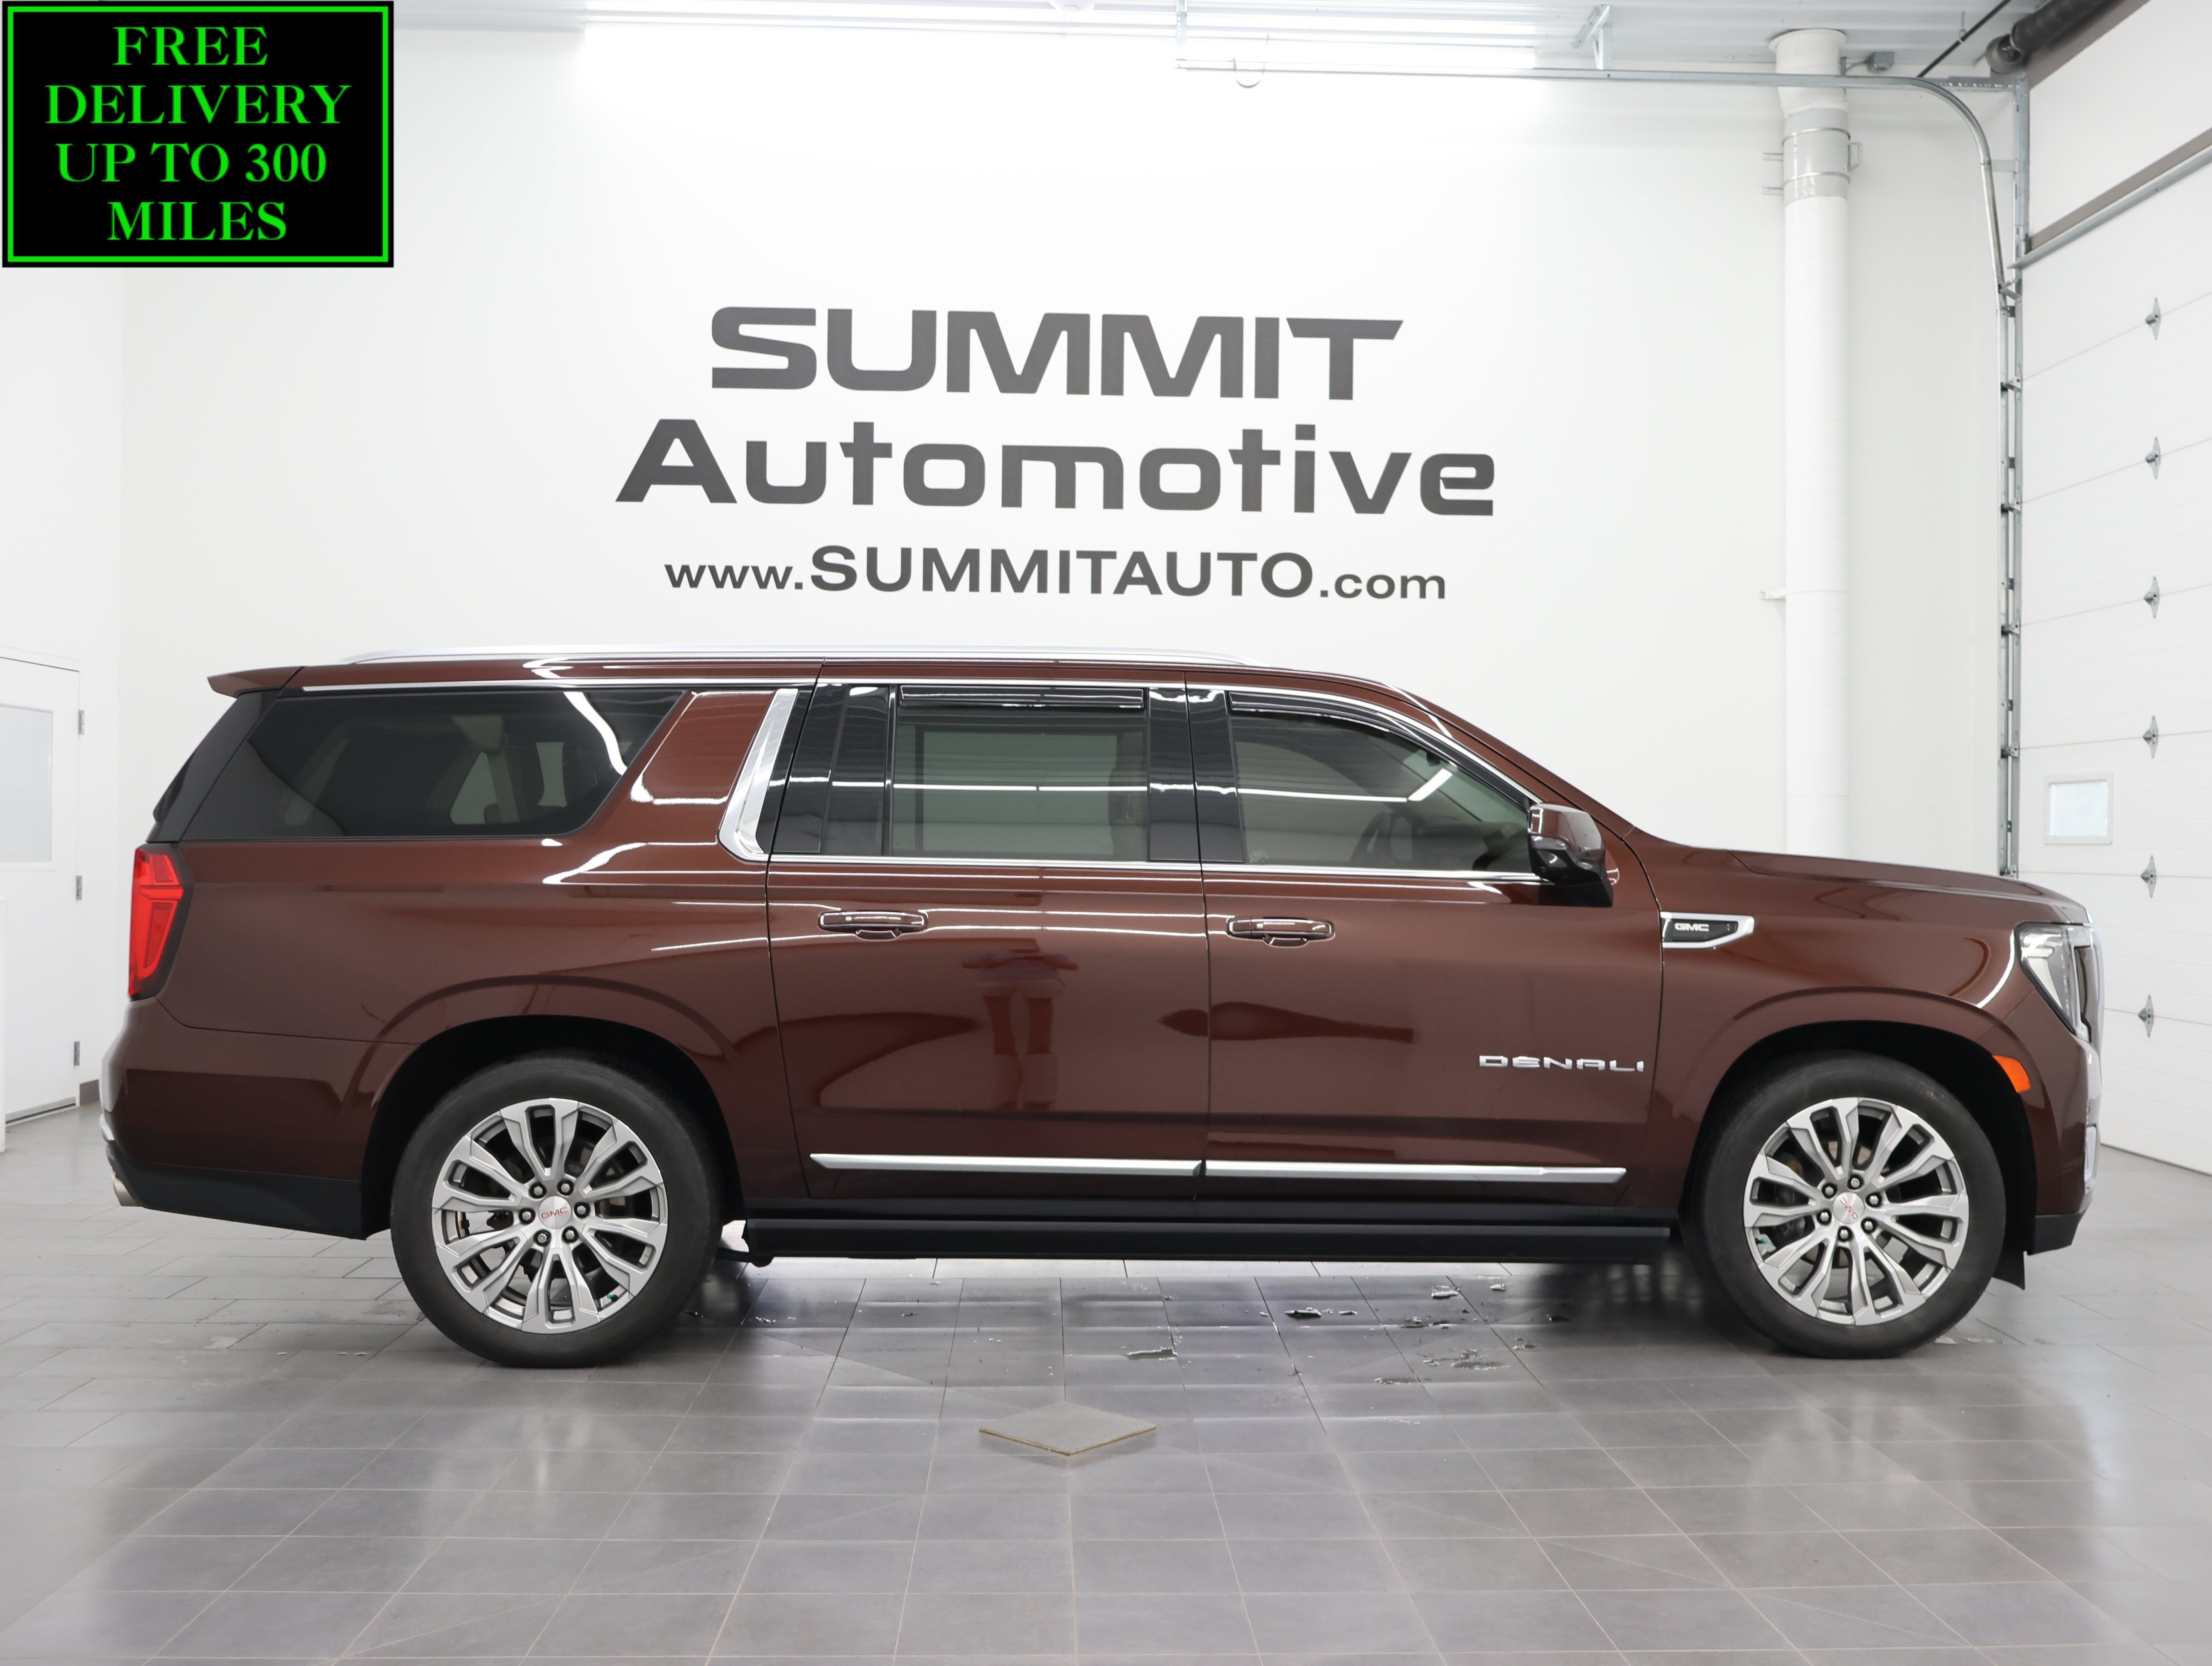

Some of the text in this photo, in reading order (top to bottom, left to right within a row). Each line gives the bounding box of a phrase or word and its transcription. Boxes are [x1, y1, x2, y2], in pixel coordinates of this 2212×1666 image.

[711, 307, 1403, 400] SUMMIT
[615, 419, 1495, 516] Automotive
[664, 545, 1445, 599] www.SUMMITAUTO.com
[1674, 922, 1709, 932] GMC
[1479, 1056, 1644, 1072] DENALI
[541, 1206, 569, 1219] GMC
[1839, 1197, 1859, 1220] GMC
